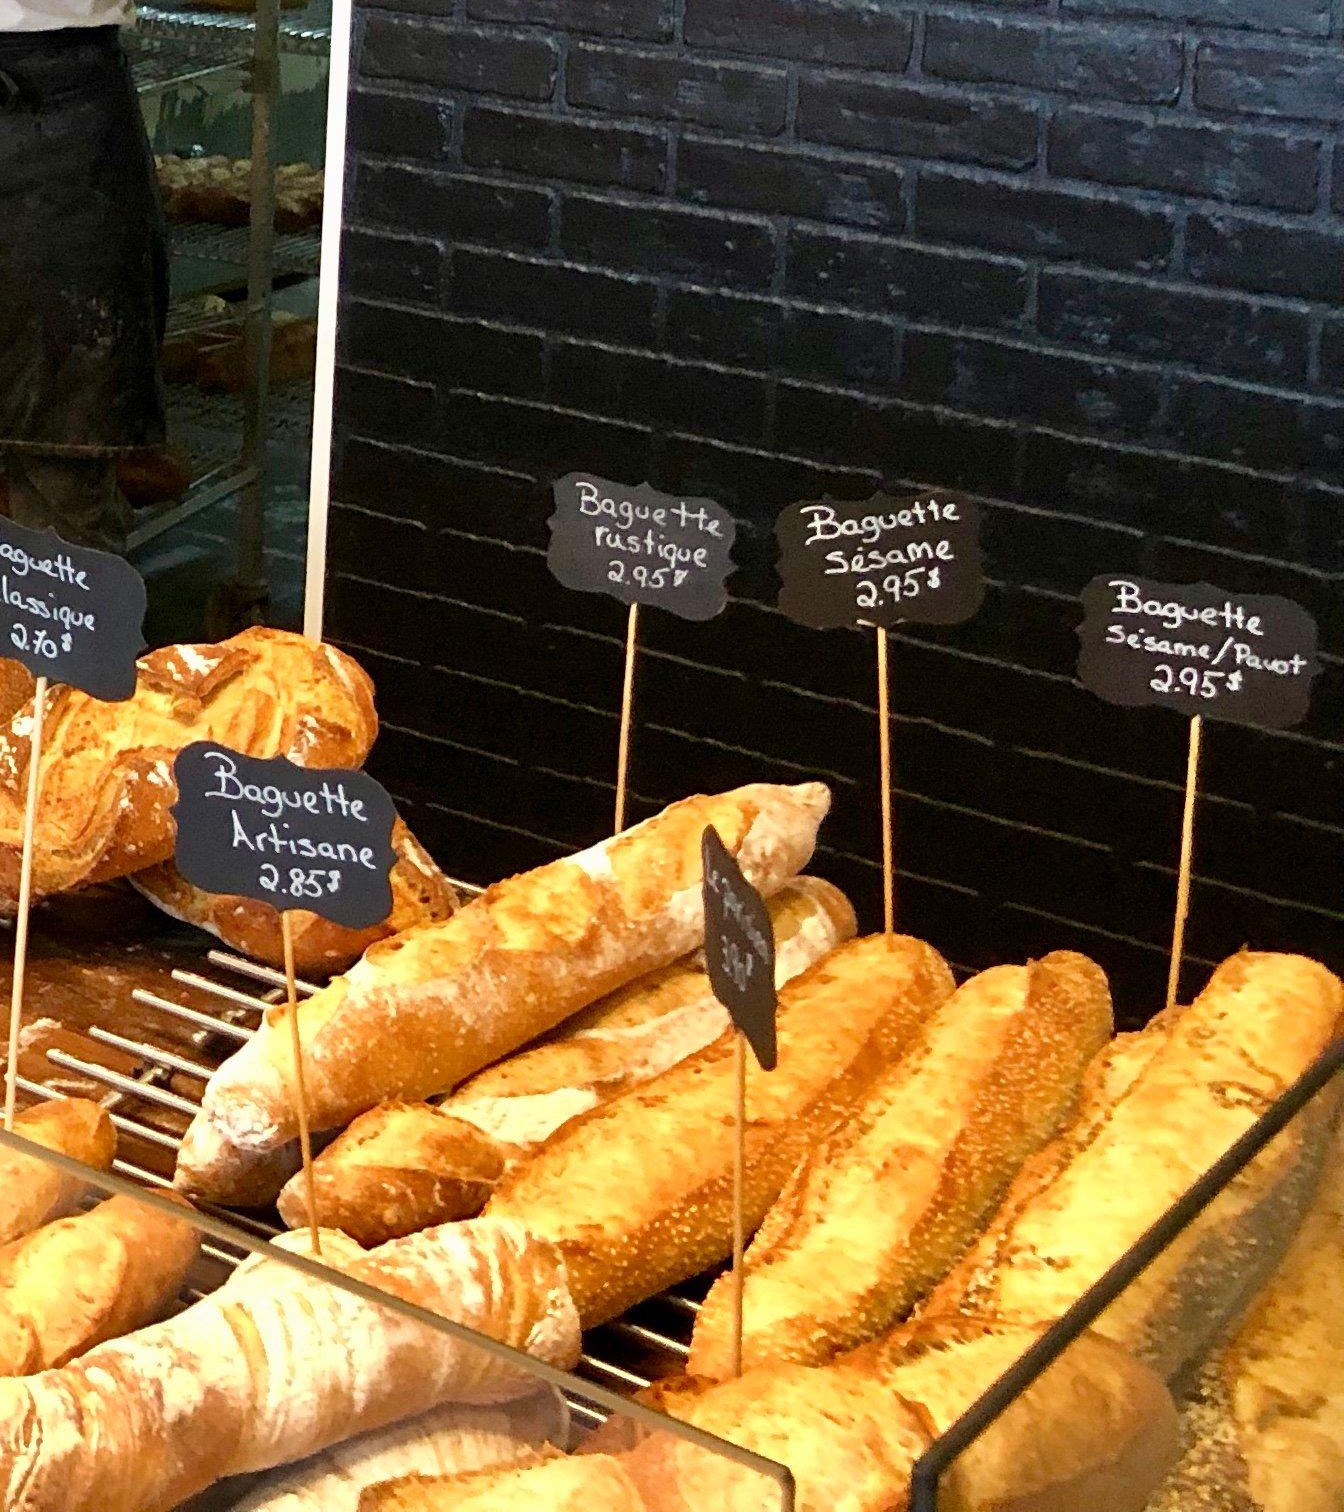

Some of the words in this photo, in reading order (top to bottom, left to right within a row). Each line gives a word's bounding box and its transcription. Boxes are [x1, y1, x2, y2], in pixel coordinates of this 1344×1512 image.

[575, 481, 724, 539] Baguette
[799, 498, 961, 547] Baguette
[595, 524, 708, 570] rustique
[607, 560, 690, 589] 2.95$
[855, 566, 942, 608] 2.95$
[1107, 580, 1265, 637] Baguette
[10, 622, 73, 659] 2.70$
[1150, 664, 1244, 699] 2.95$
[203, 750, 370, 822] Baguette
[230, 809, 378, 870] Artisane
[258, 862, 342, 898] 2.85$
